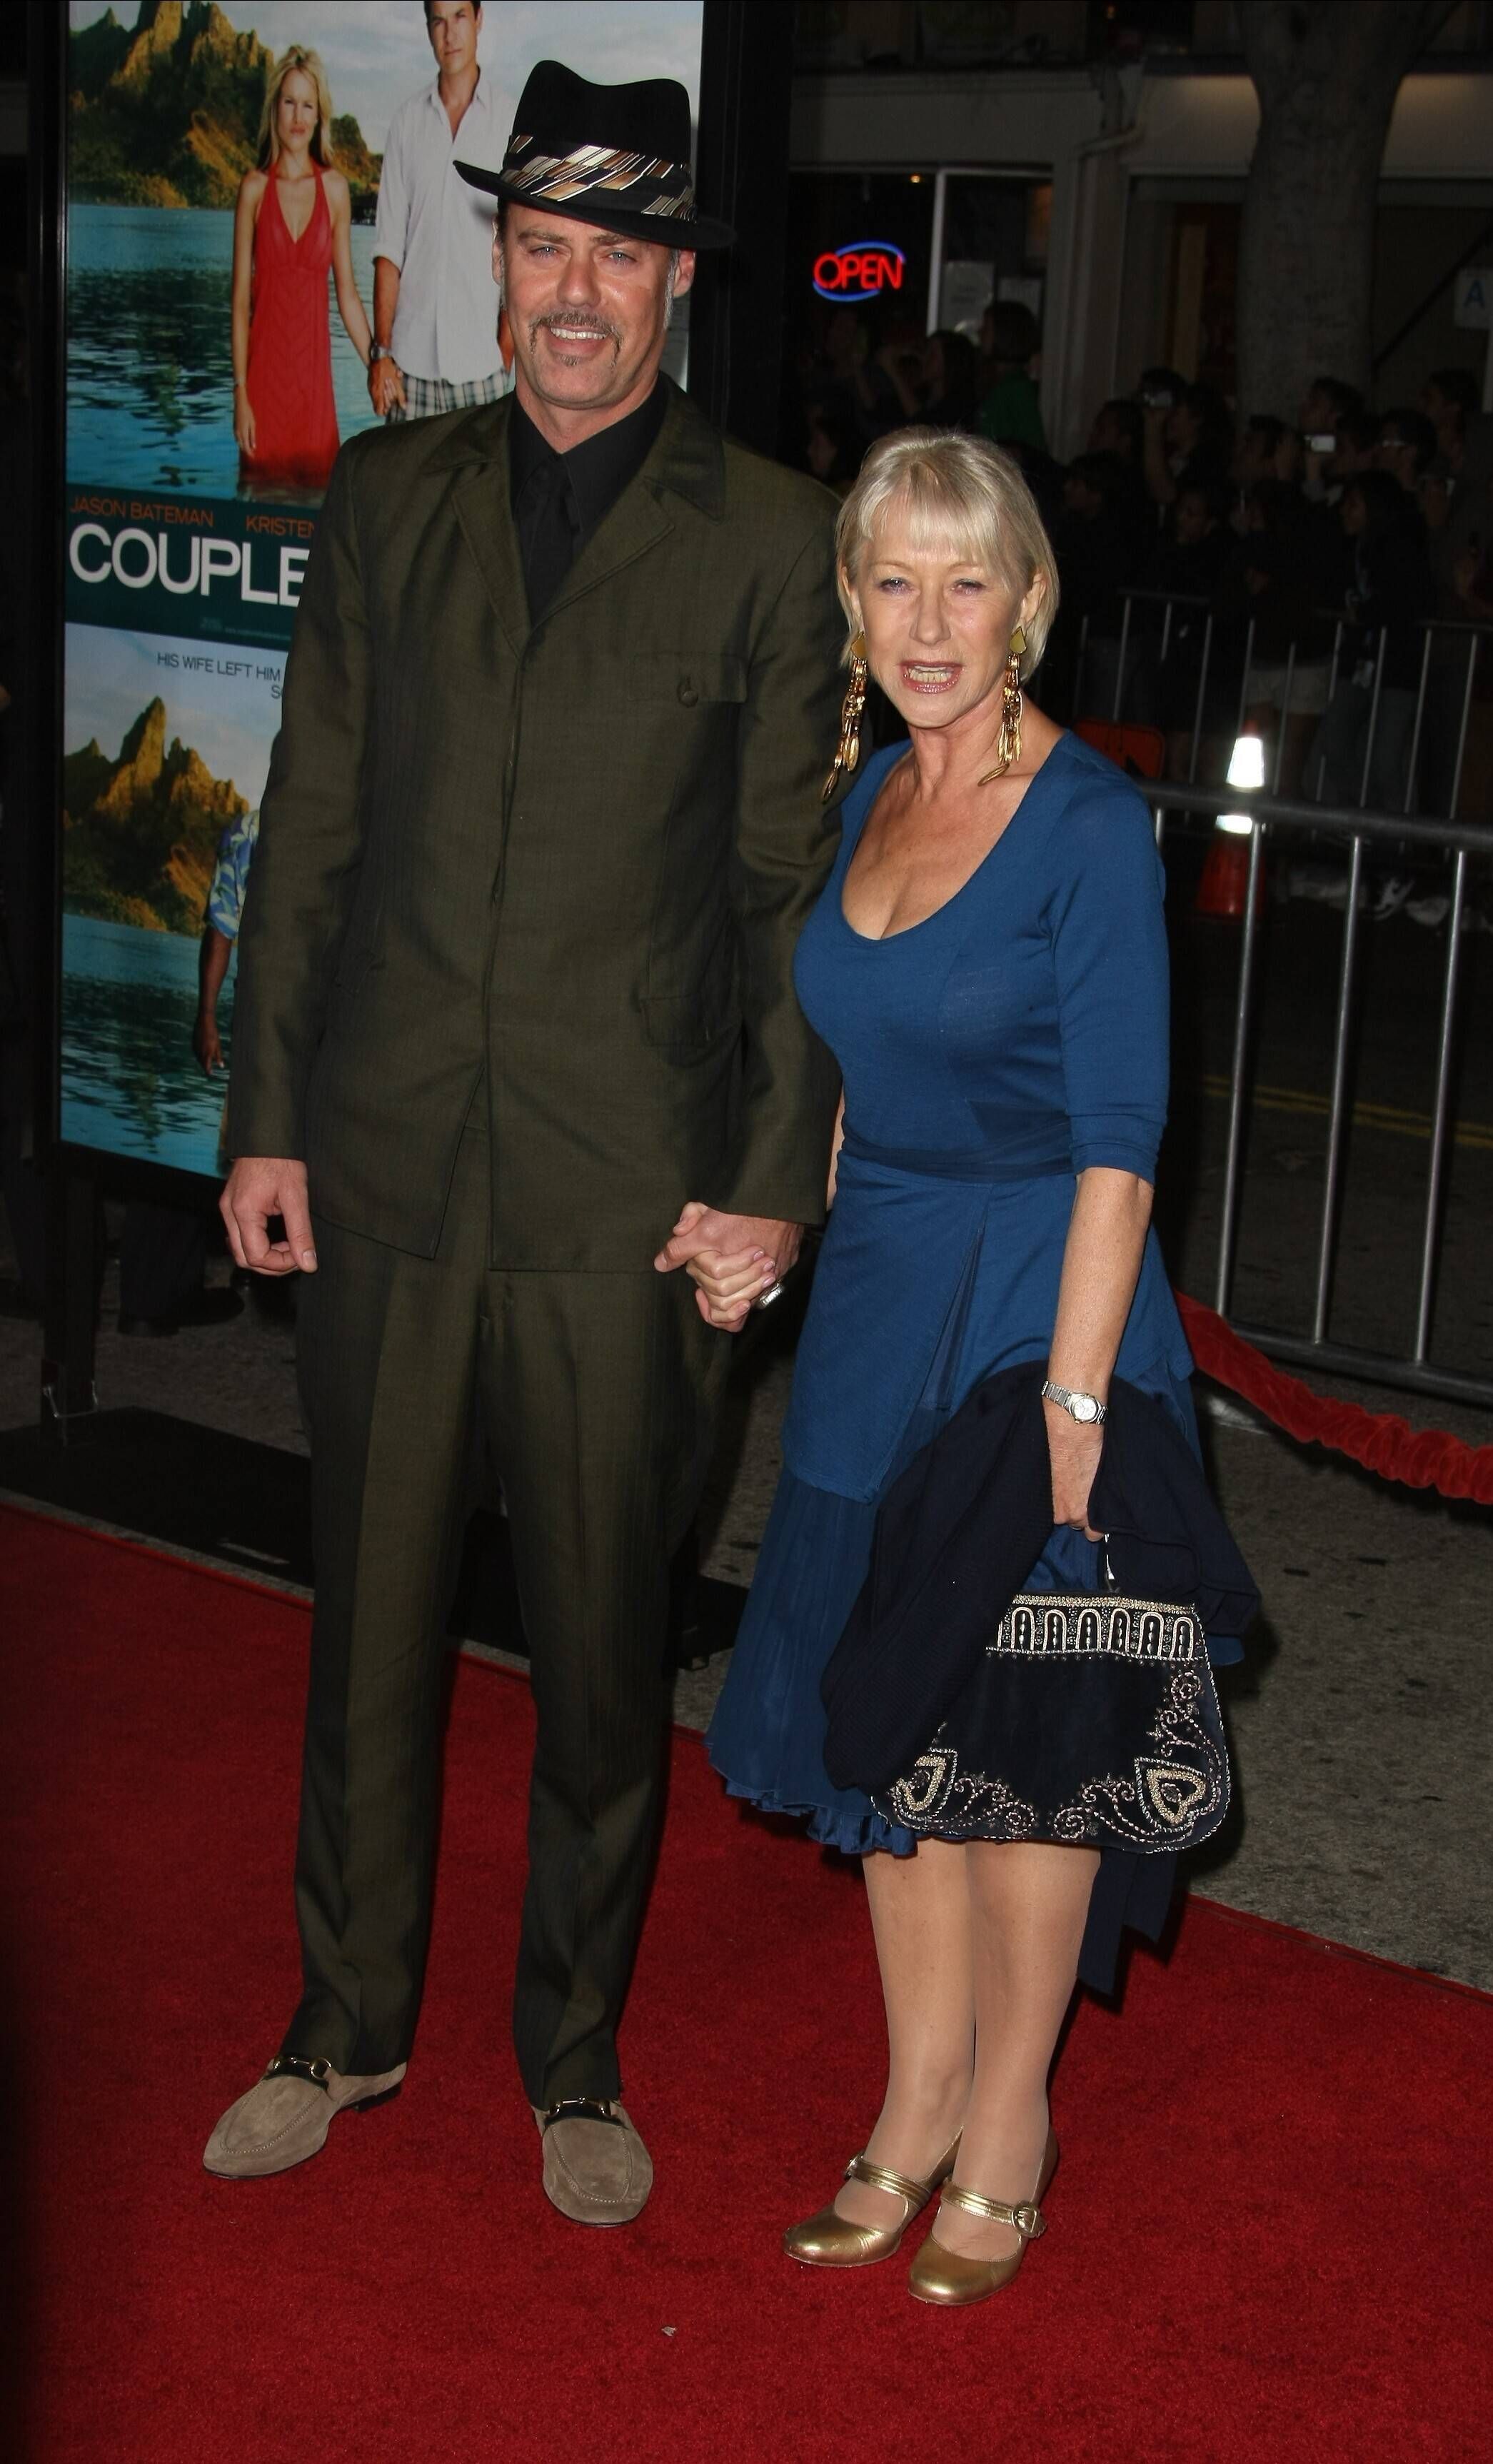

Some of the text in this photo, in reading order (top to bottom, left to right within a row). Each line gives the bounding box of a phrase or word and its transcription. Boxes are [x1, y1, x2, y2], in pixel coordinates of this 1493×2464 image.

[813, 253, 903, 290] OPEN
[1463, 280, 1485, 308] A
[71, 496, 213, 528] JASON BATEMAN
[157, 652, 281, 682] HIS WIFE LEFT HIM
